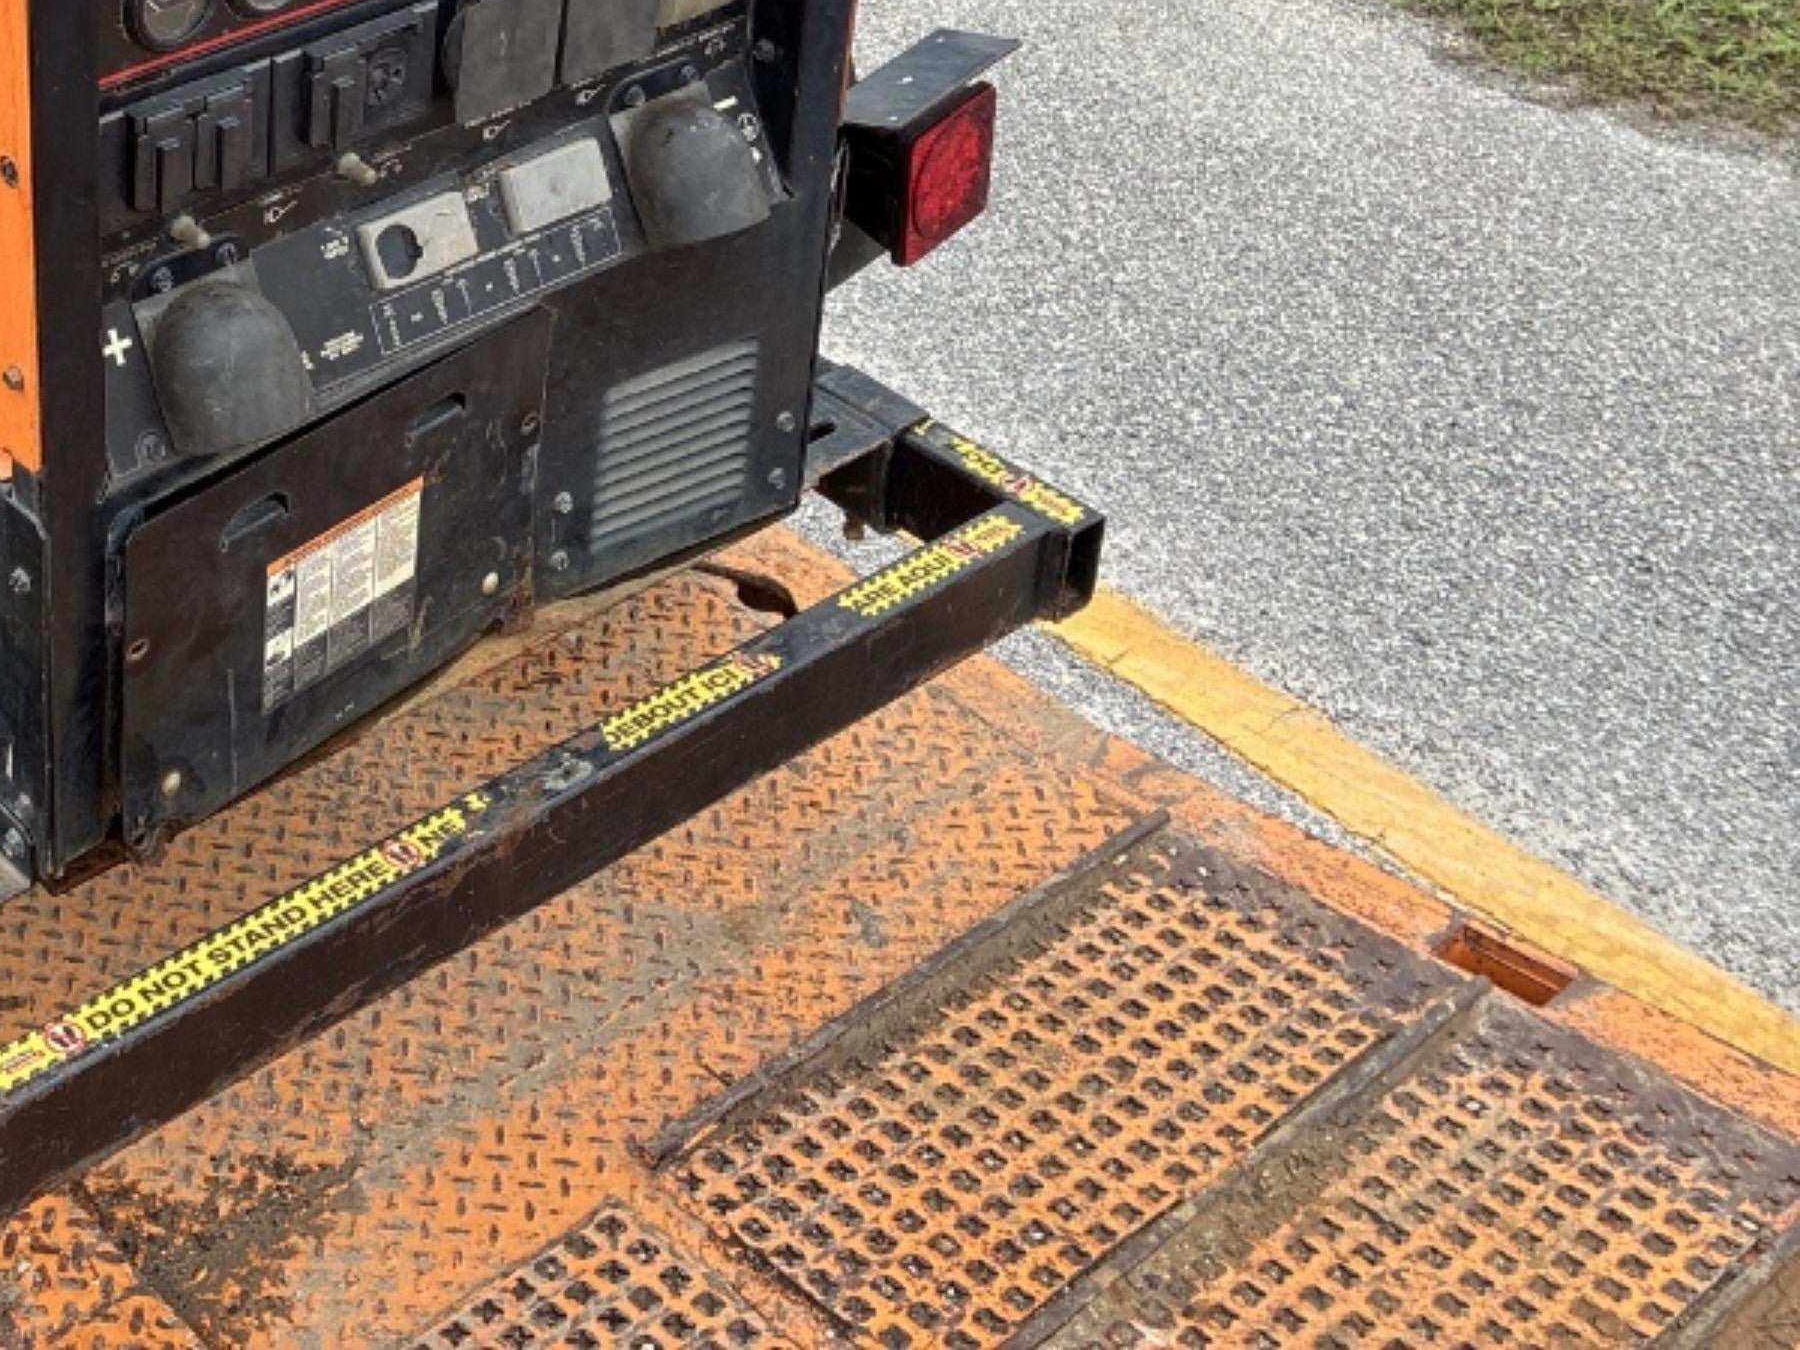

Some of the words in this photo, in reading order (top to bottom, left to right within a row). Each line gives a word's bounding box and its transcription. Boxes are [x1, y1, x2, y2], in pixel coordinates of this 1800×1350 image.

[704, 668, 740, 693] ICI
[85, 997, 136, 1031] DO
[138, 957, 204, 1003] NOT
[206, 904, 308, 965] STAND
[308, 858, 391, 911] HERE
